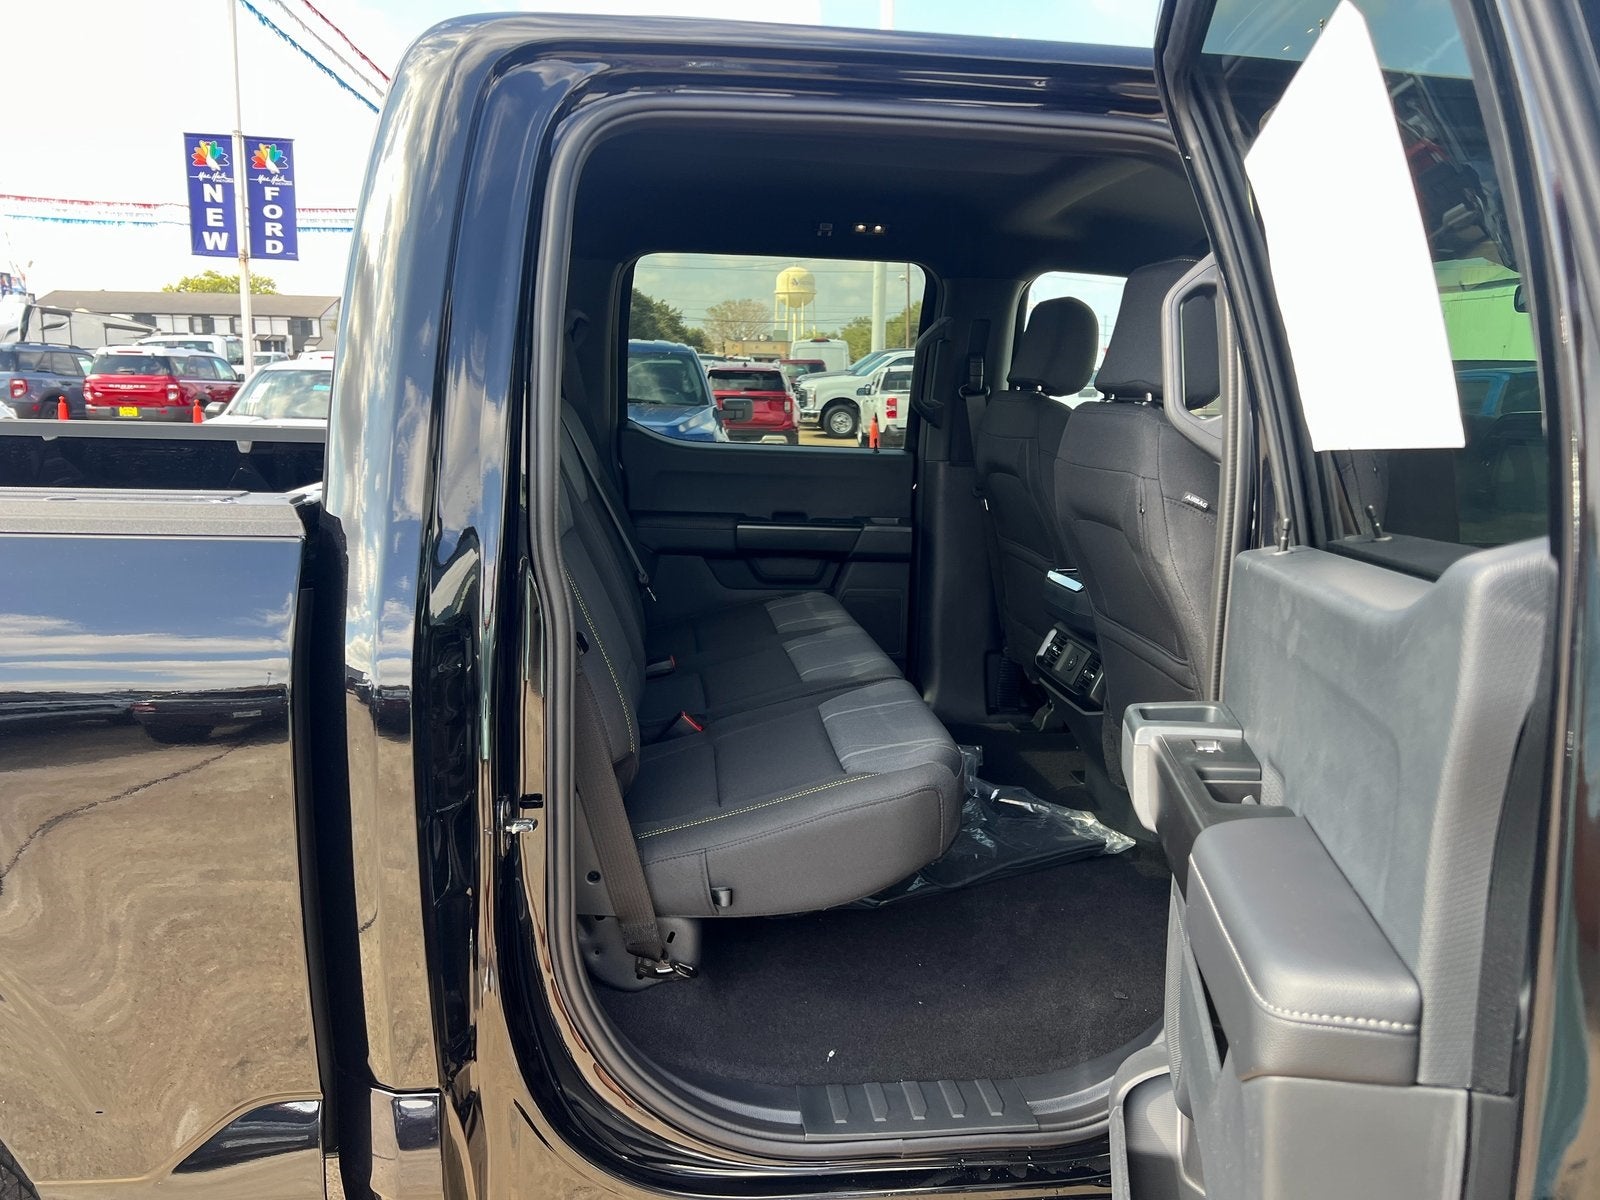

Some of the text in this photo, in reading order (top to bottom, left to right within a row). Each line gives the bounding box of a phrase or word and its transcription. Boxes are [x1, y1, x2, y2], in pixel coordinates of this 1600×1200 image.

[202, 183, 228, 251] NEW
[262, 186, 284, 254] FORD
[1184, 494, 1208, 508] AIRBAG
